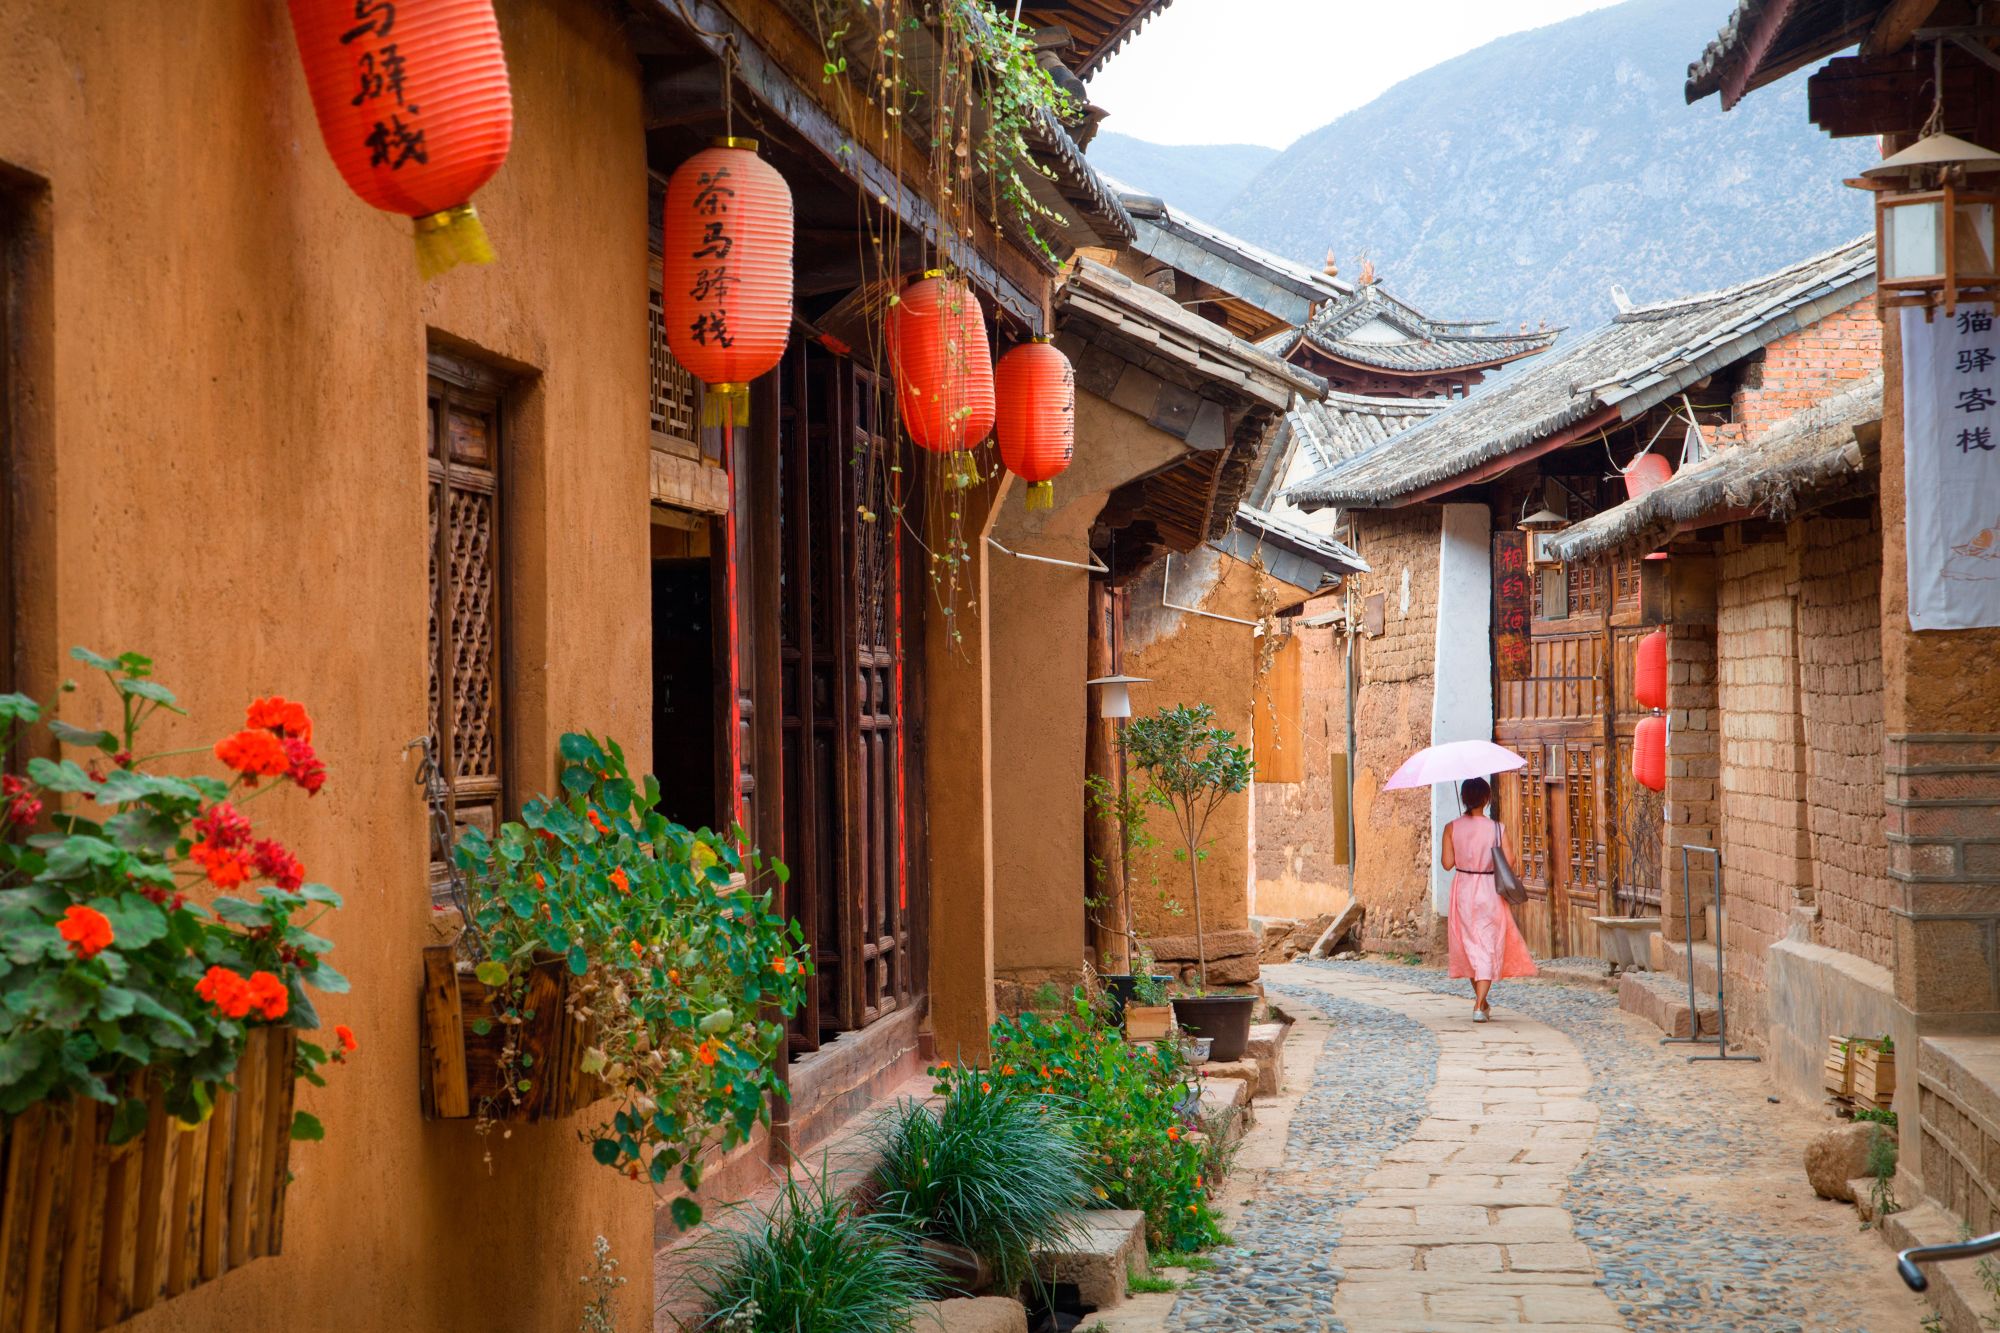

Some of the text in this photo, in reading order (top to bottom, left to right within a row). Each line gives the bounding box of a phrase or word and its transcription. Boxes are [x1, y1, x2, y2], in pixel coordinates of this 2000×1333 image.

[689, 167, 741, 349] 茶马驿栈
[1954, 309, 1997, 454] 猫驿客栈
